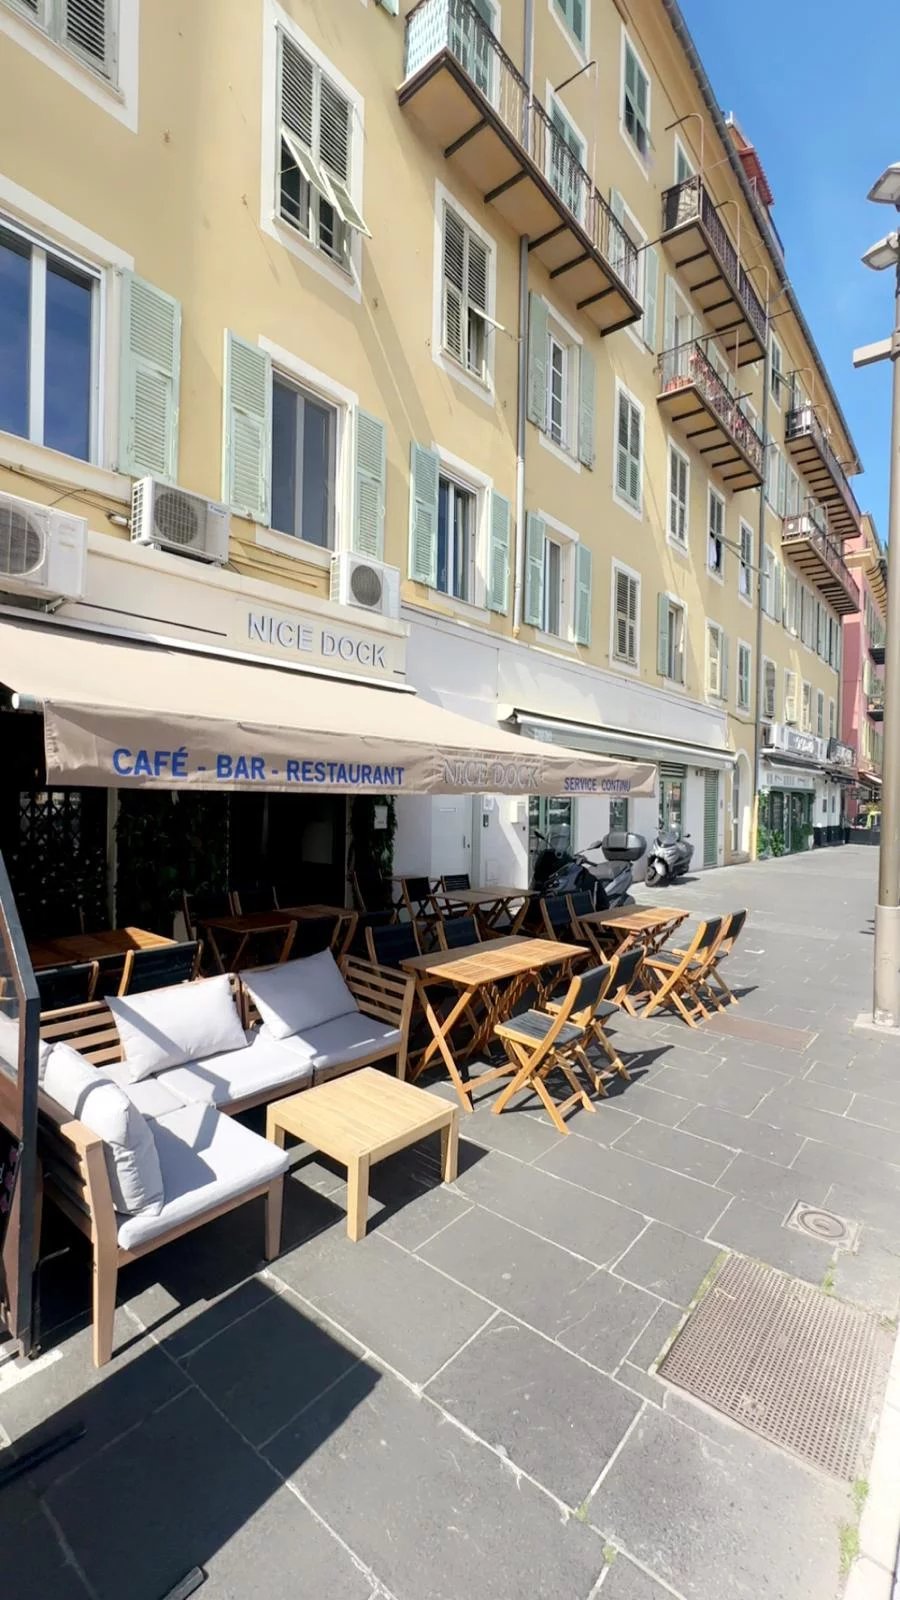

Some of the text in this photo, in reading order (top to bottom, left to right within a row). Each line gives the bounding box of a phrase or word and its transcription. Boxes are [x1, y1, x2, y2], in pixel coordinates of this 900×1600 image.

[248, 613, 386, 668] NICE DOCK
[112, 746, 189, 777] CAFÉ
[216, 754, 266, 780] BAR
[286, 759, 405, 785] RESTAURANT
[443, 759, 539, 788] NICE DOCK
[564, 777, 631, 793] SERVICE CONTINU
